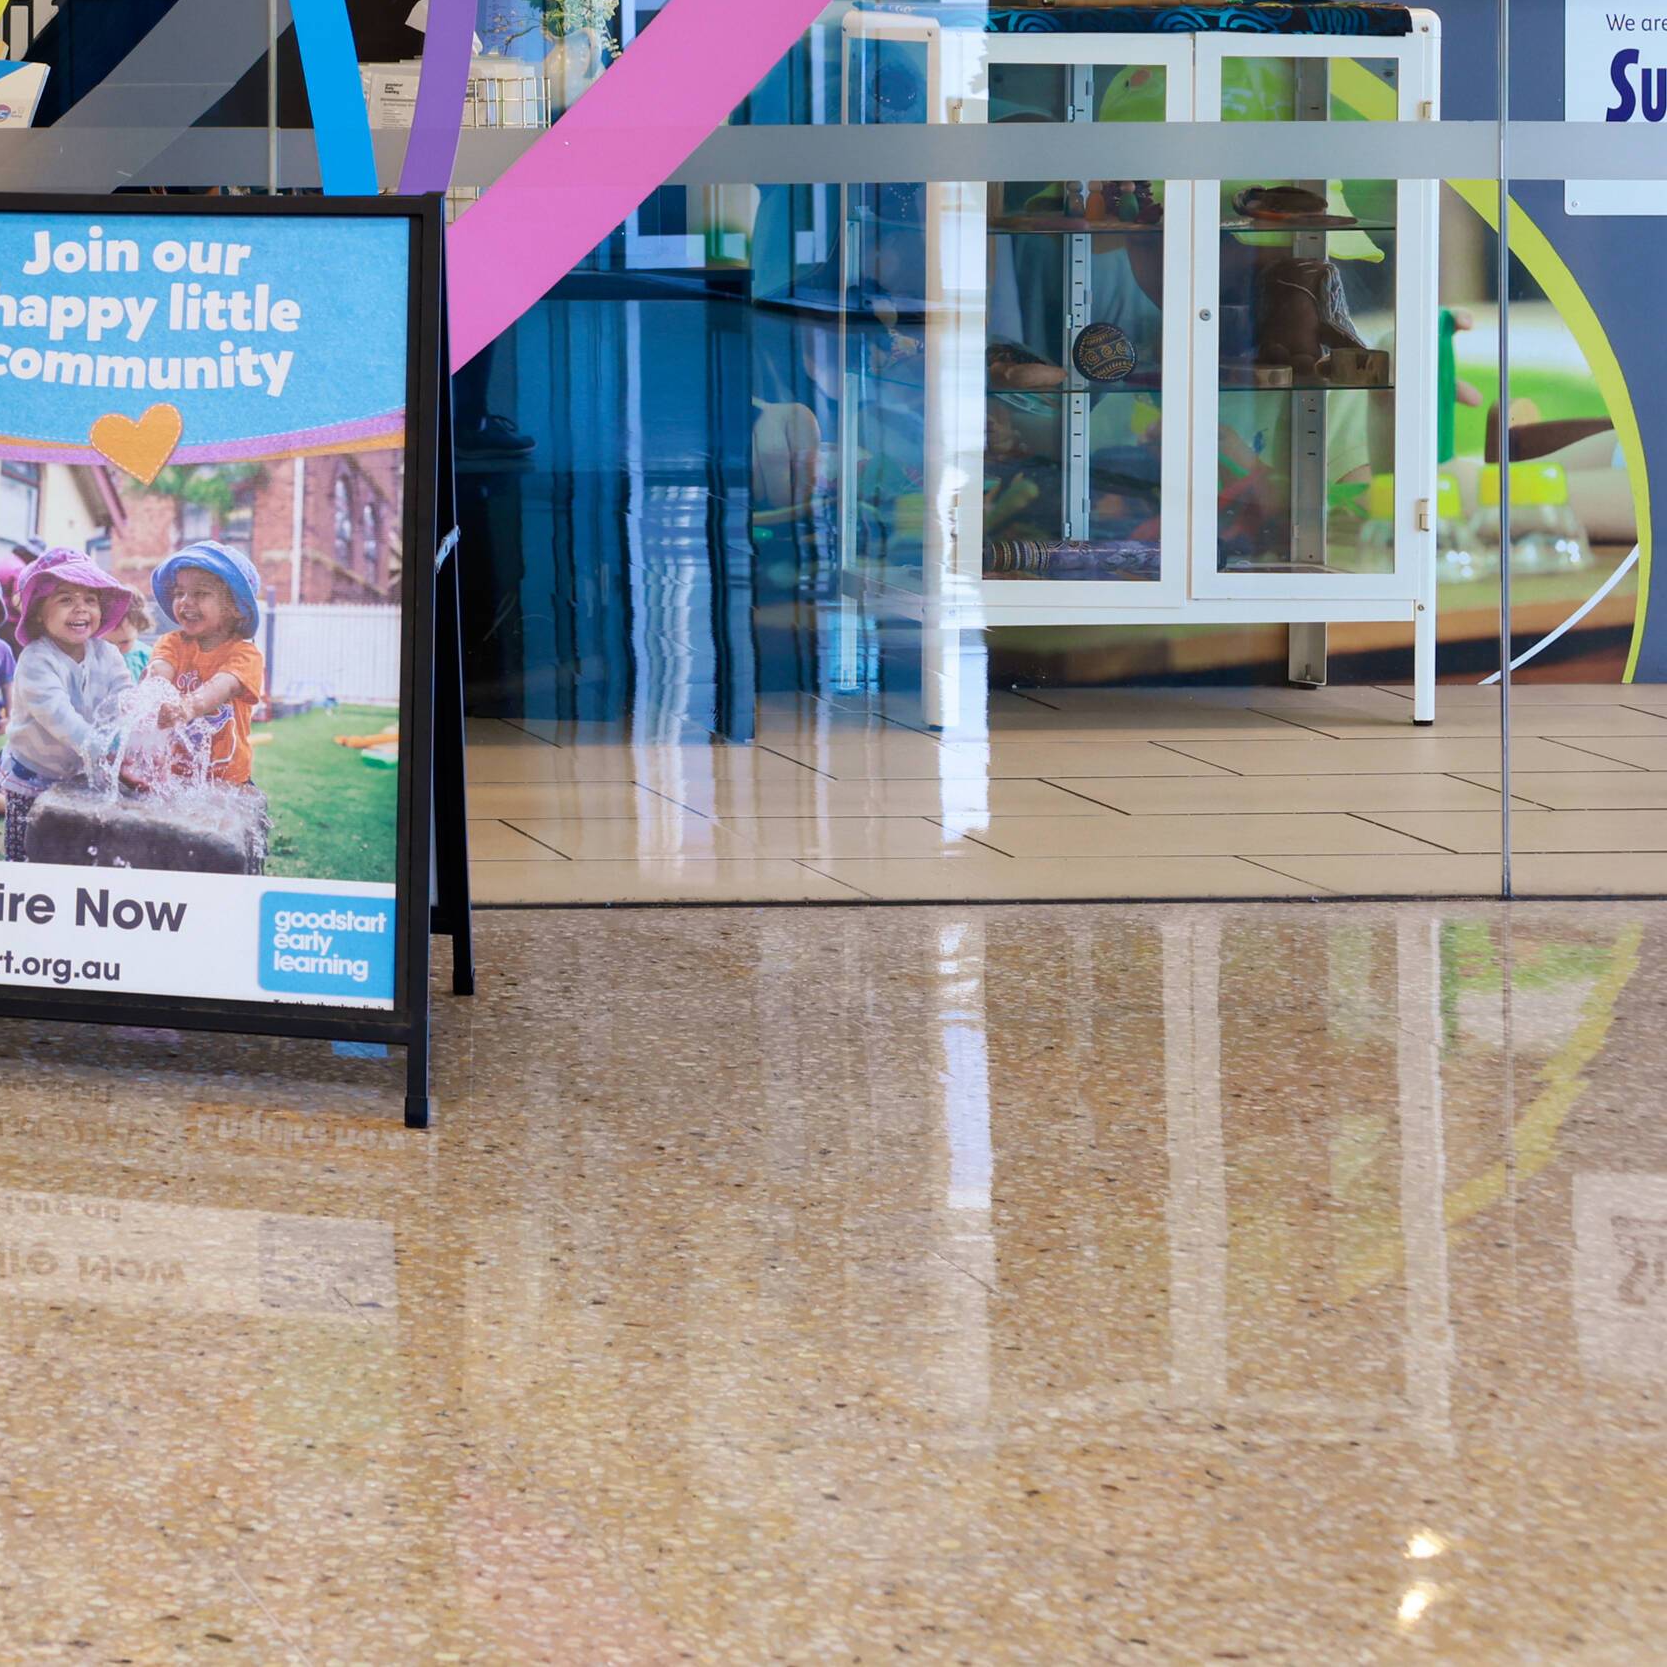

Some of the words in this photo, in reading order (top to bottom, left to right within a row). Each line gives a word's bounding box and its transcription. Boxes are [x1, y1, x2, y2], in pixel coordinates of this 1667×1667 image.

[1606, 13, 1636, 31] We
[1641, 18, 1667, 31] are
[22, 224, 139, 276] Join
[153, 238, 252, 276] our
[169, 282, 301, 333] little
[75, 887, 188, 933] Now
[274, 909, 387, 933] goodstart
[273, 930, 333, 956] early
[273, 950, 369, 982] learning
